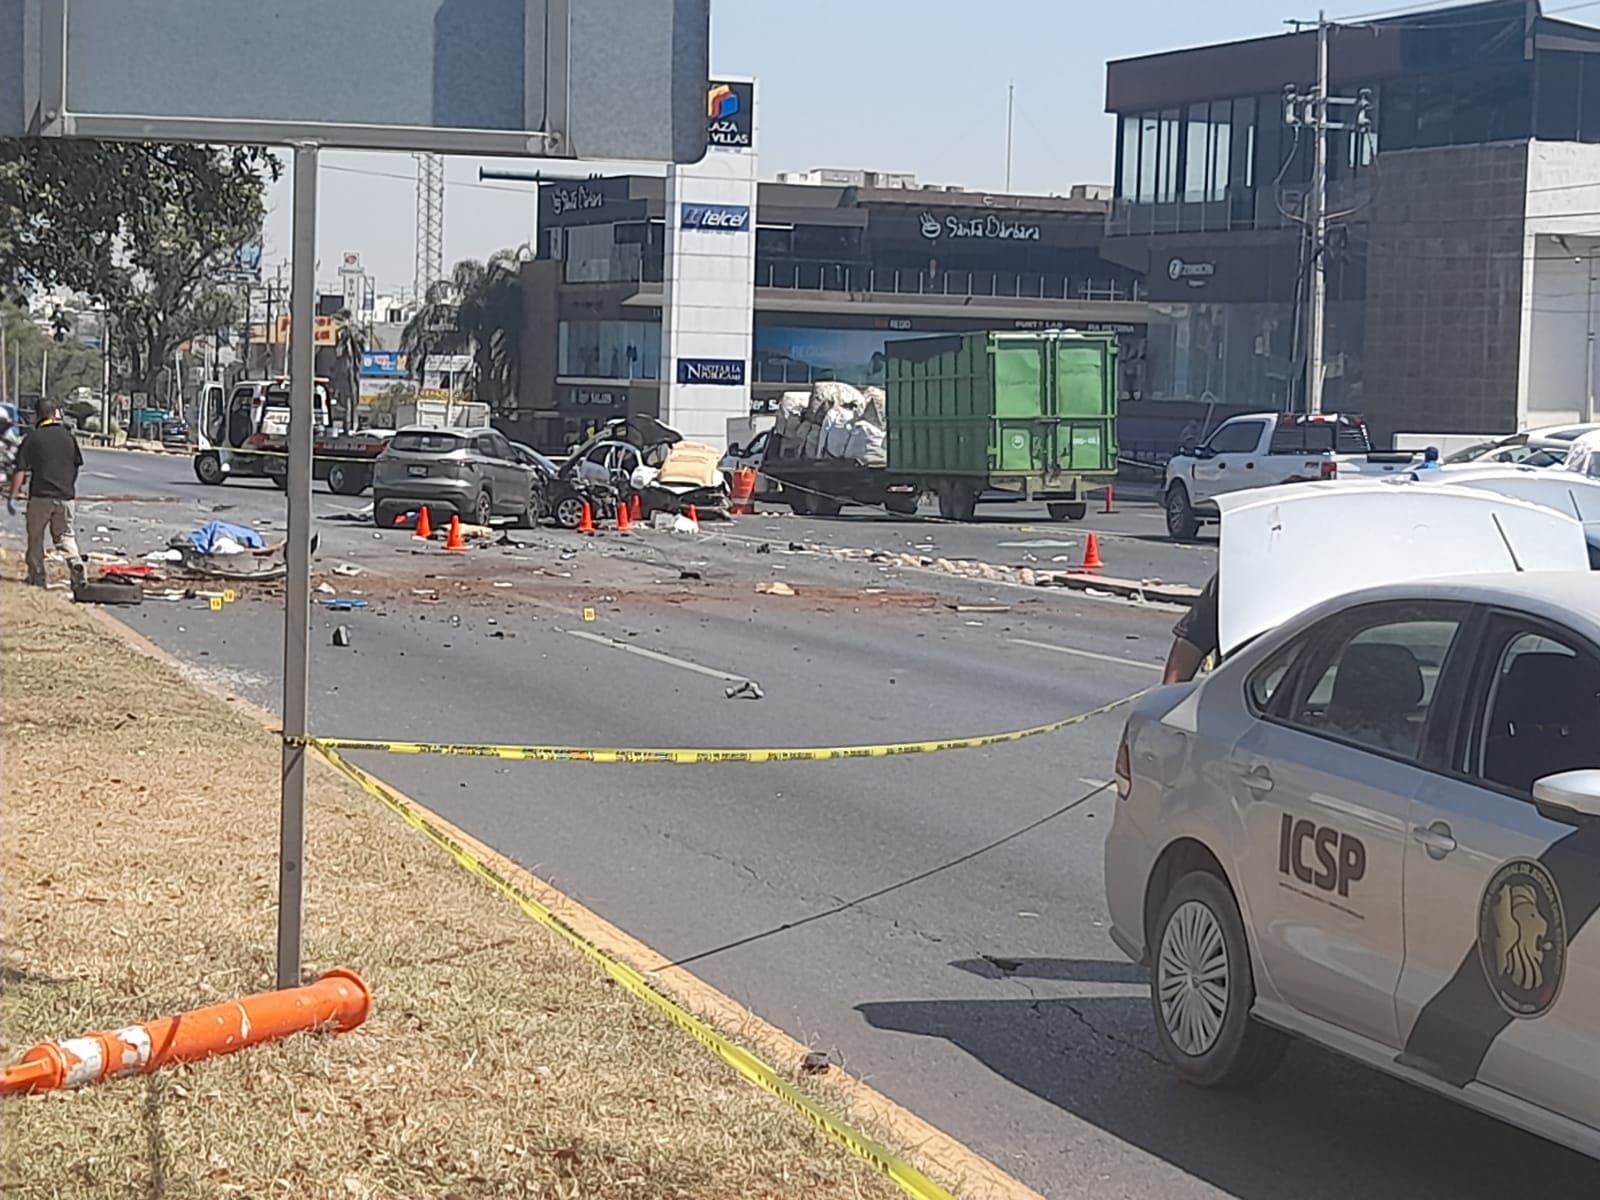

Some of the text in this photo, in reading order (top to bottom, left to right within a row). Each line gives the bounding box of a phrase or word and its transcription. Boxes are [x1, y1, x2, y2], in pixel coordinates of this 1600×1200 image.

[701, 208, 748, 227] telcel
[945, 215, 984, 238] Santa
[1278, 812, 1367, 898] ICSP
